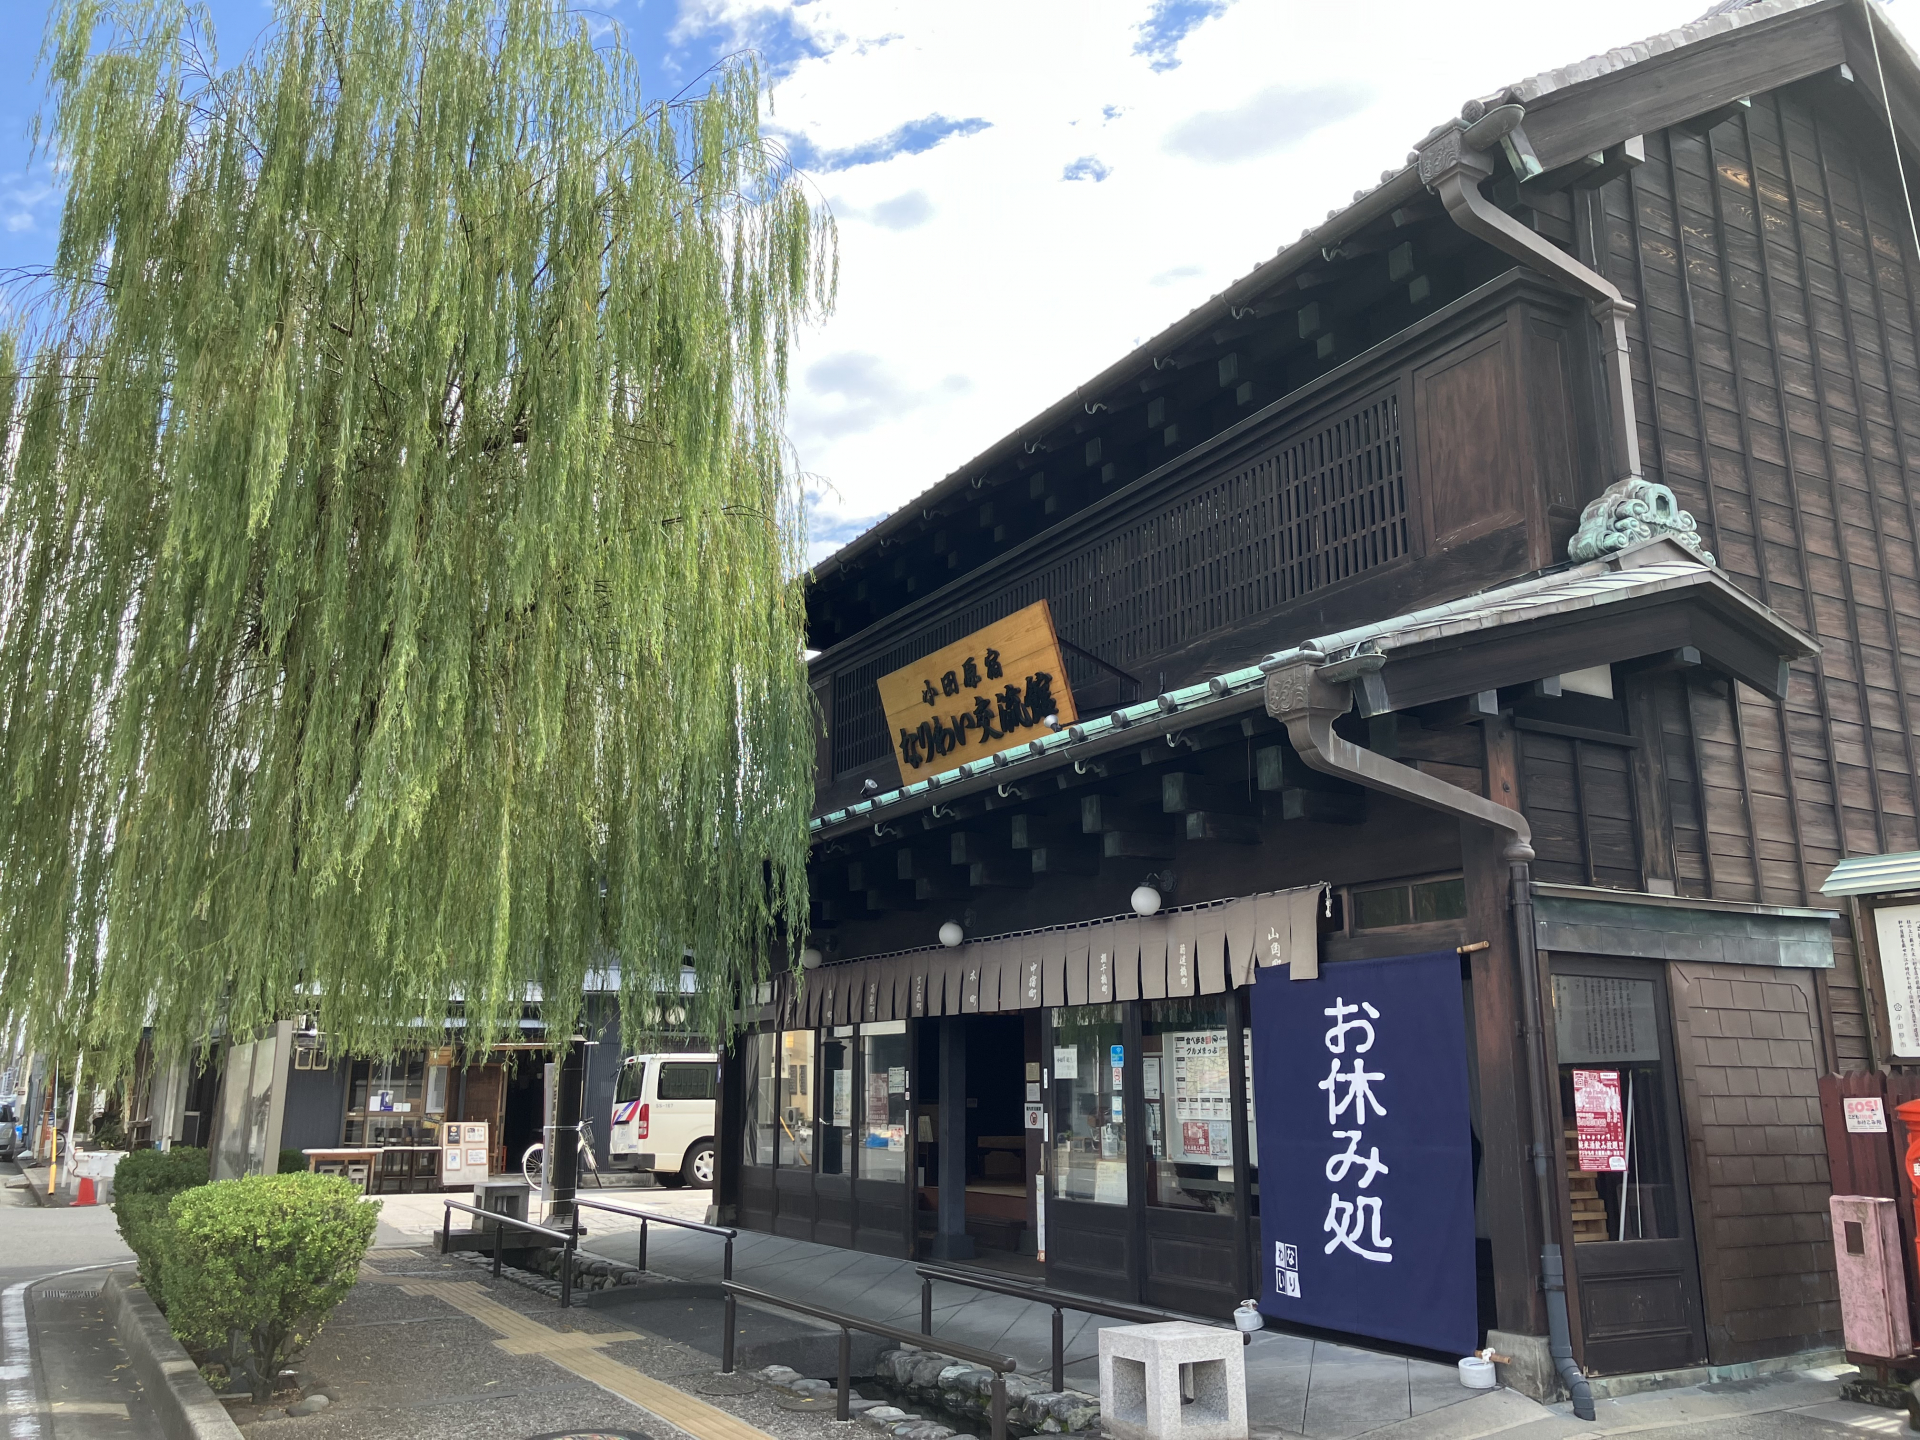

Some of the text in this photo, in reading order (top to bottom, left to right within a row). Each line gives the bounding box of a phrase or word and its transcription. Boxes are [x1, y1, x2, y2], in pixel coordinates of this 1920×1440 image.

[922, 648, 1003, 706] 小田原宿
[899, 672, 1059, 769] なりわい交流館
[1318, 997, 1392, 1262] お休み処
[1847, 1100, 1878, 1113] SOS!
